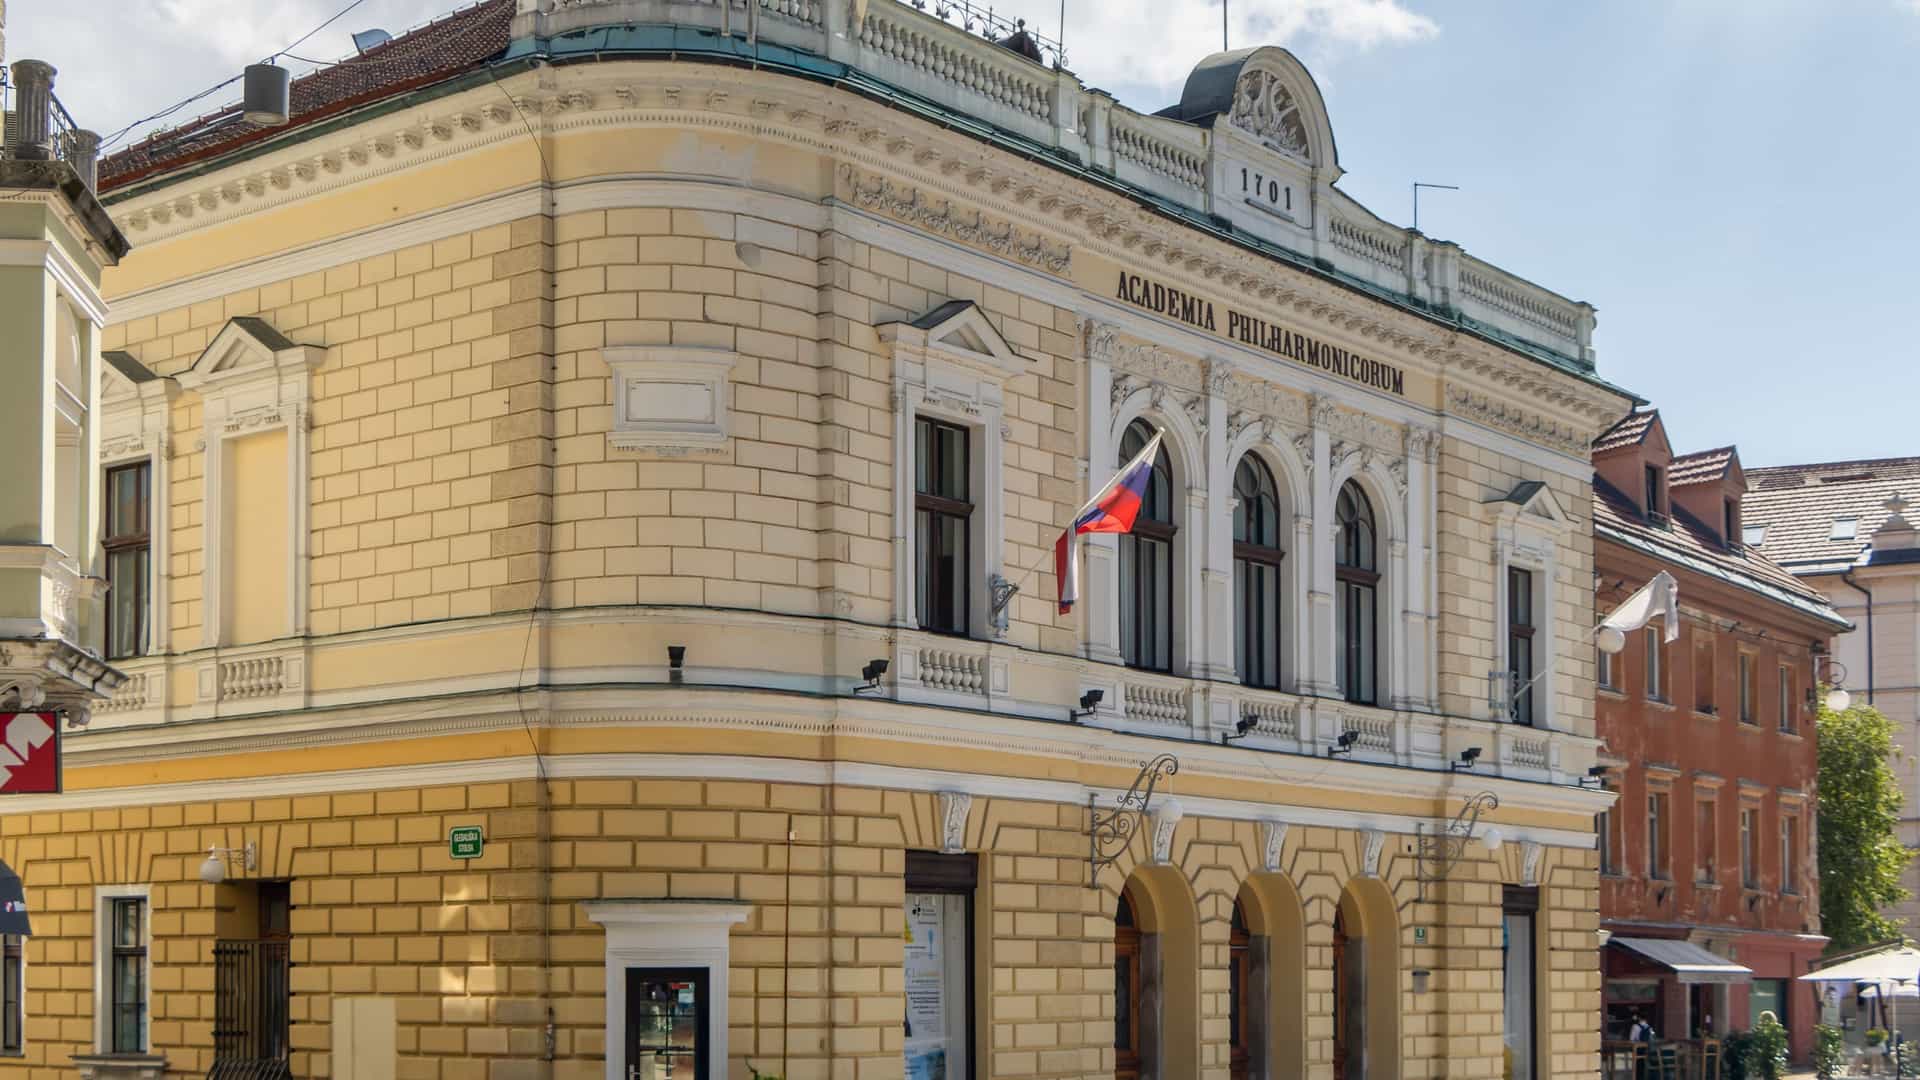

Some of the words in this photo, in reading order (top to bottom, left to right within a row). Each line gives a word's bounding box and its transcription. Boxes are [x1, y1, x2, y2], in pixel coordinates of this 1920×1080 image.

[1241, 168, 1291, 210] 1701
[1116, 271, 1216, 331] ACADEMIA
[1228, 310, 1404, 395] PHILHARMONICORUM
